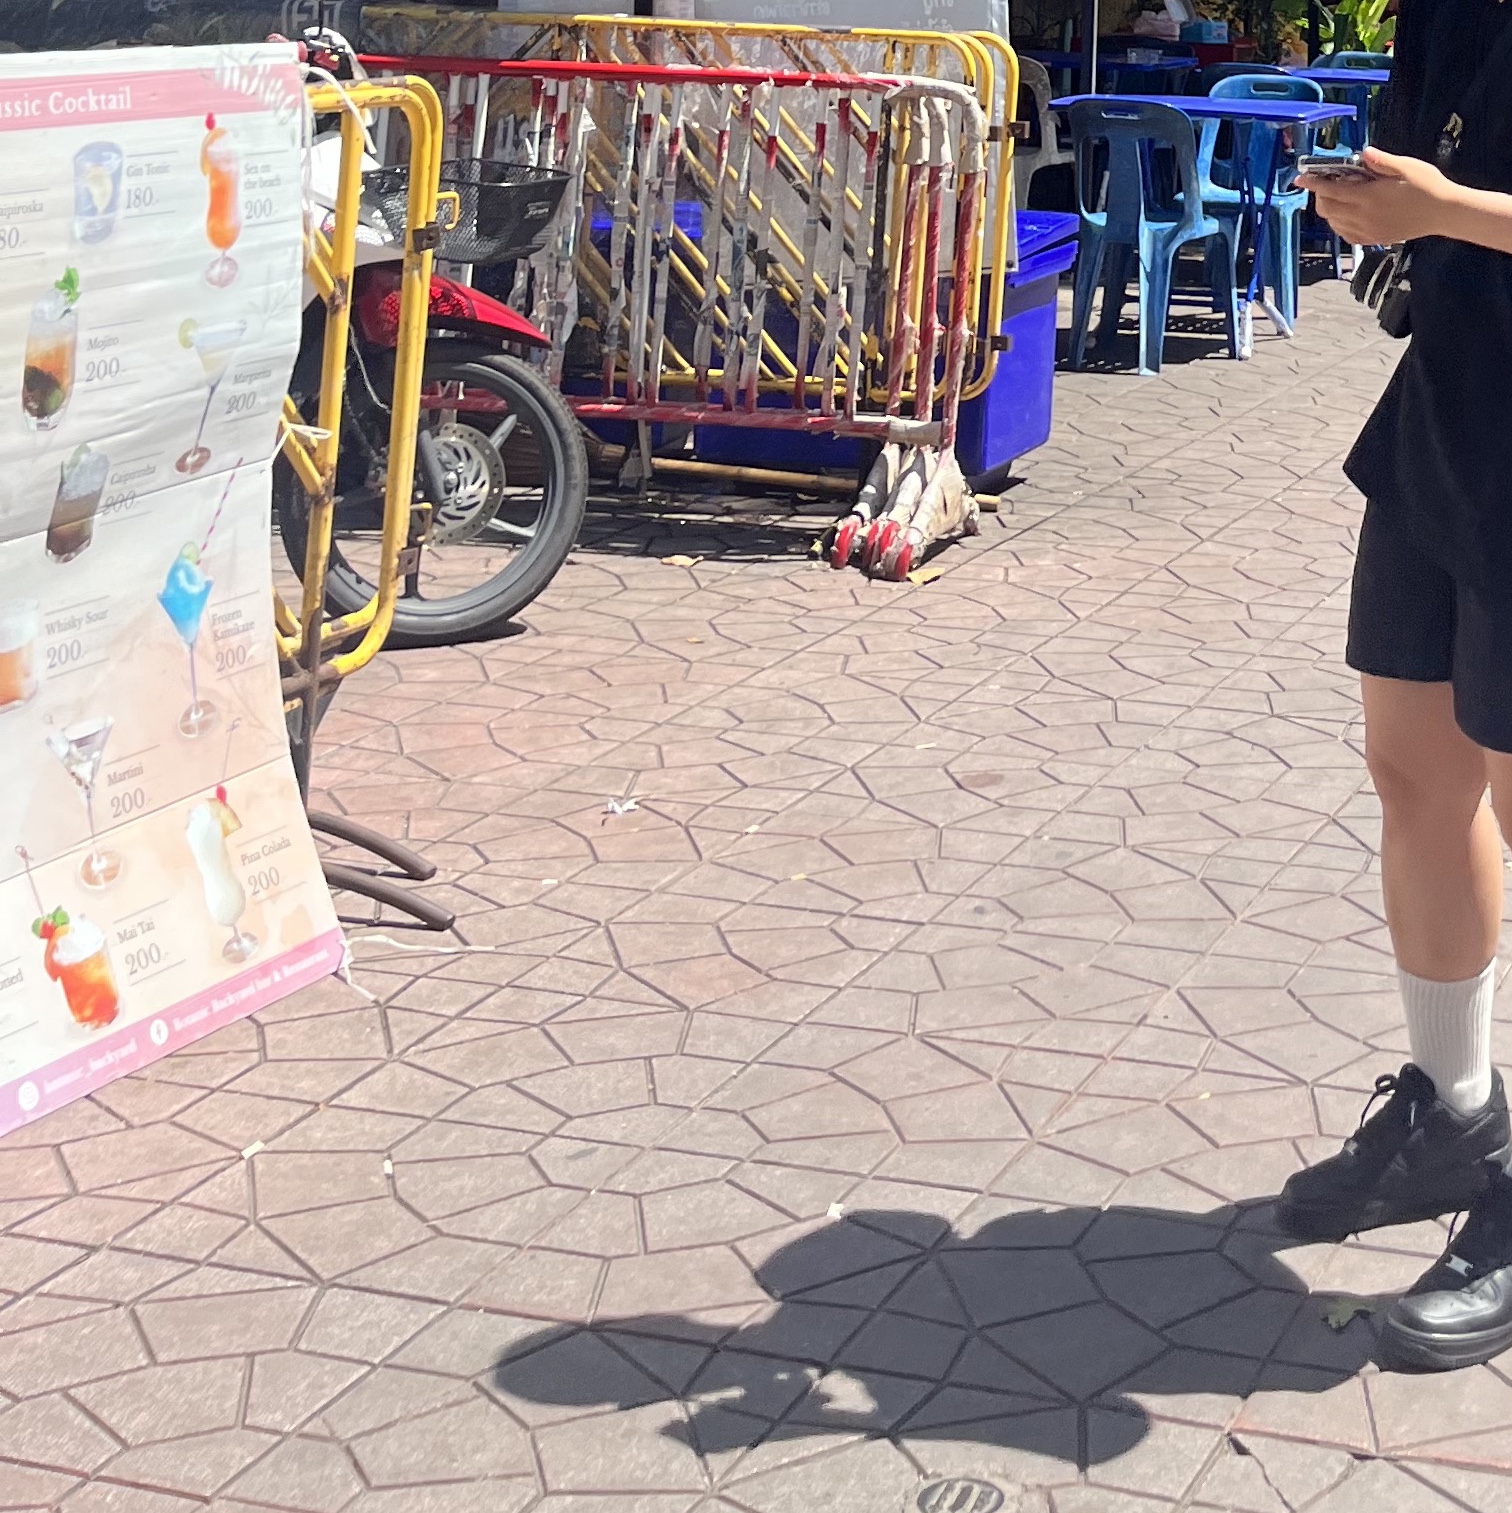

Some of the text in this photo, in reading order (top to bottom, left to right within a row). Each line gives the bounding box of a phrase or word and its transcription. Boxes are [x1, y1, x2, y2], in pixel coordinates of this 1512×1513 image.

[0, 85, 132, 118] ssic Cocktail
[45, 607, 109, 636] Whisky Sour
[212, 609, 242, 627] Frozen
[106, 763, 144, 787] Martini
[261, 837, 292, 858] Colada
[116, 926, 137, 945] Mai
